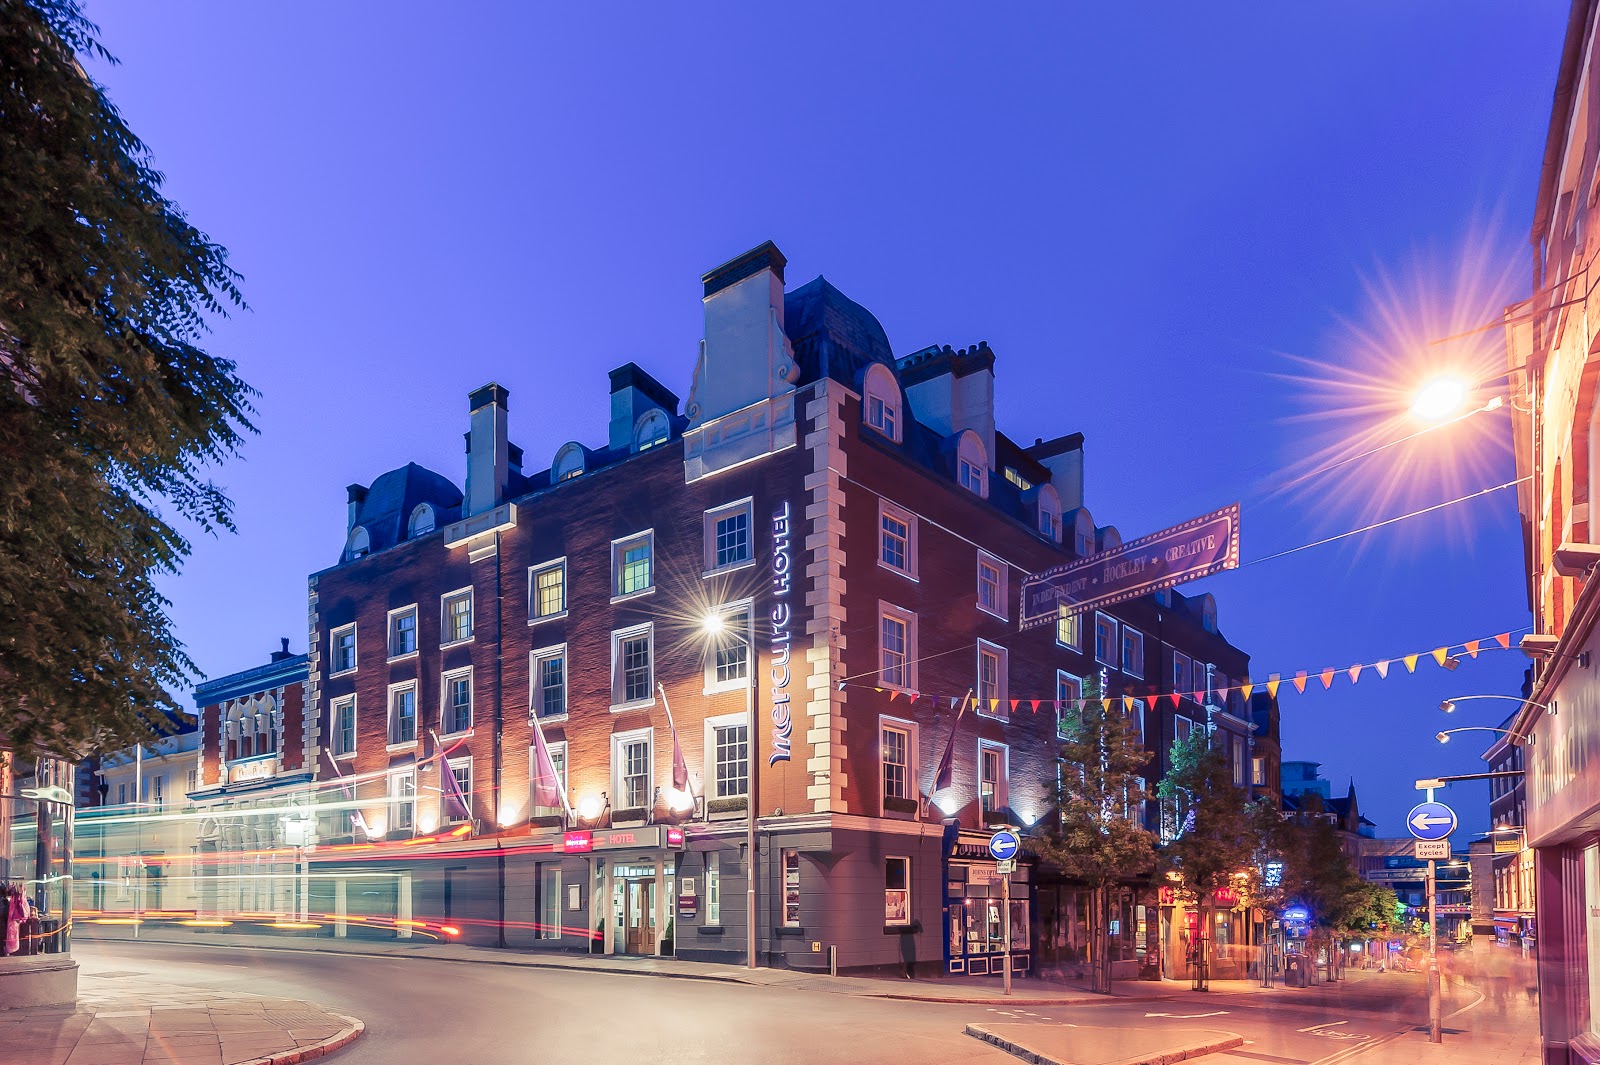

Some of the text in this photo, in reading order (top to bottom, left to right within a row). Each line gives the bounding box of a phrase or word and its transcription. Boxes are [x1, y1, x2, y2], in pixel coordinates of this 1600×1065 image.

[773, 501, 790, 596] HOTEL
[1033, 534, 1215, 606] INDEPENDENT HOCKLEY CREATIVE
[609, 834, 636, 844] HOTEL
